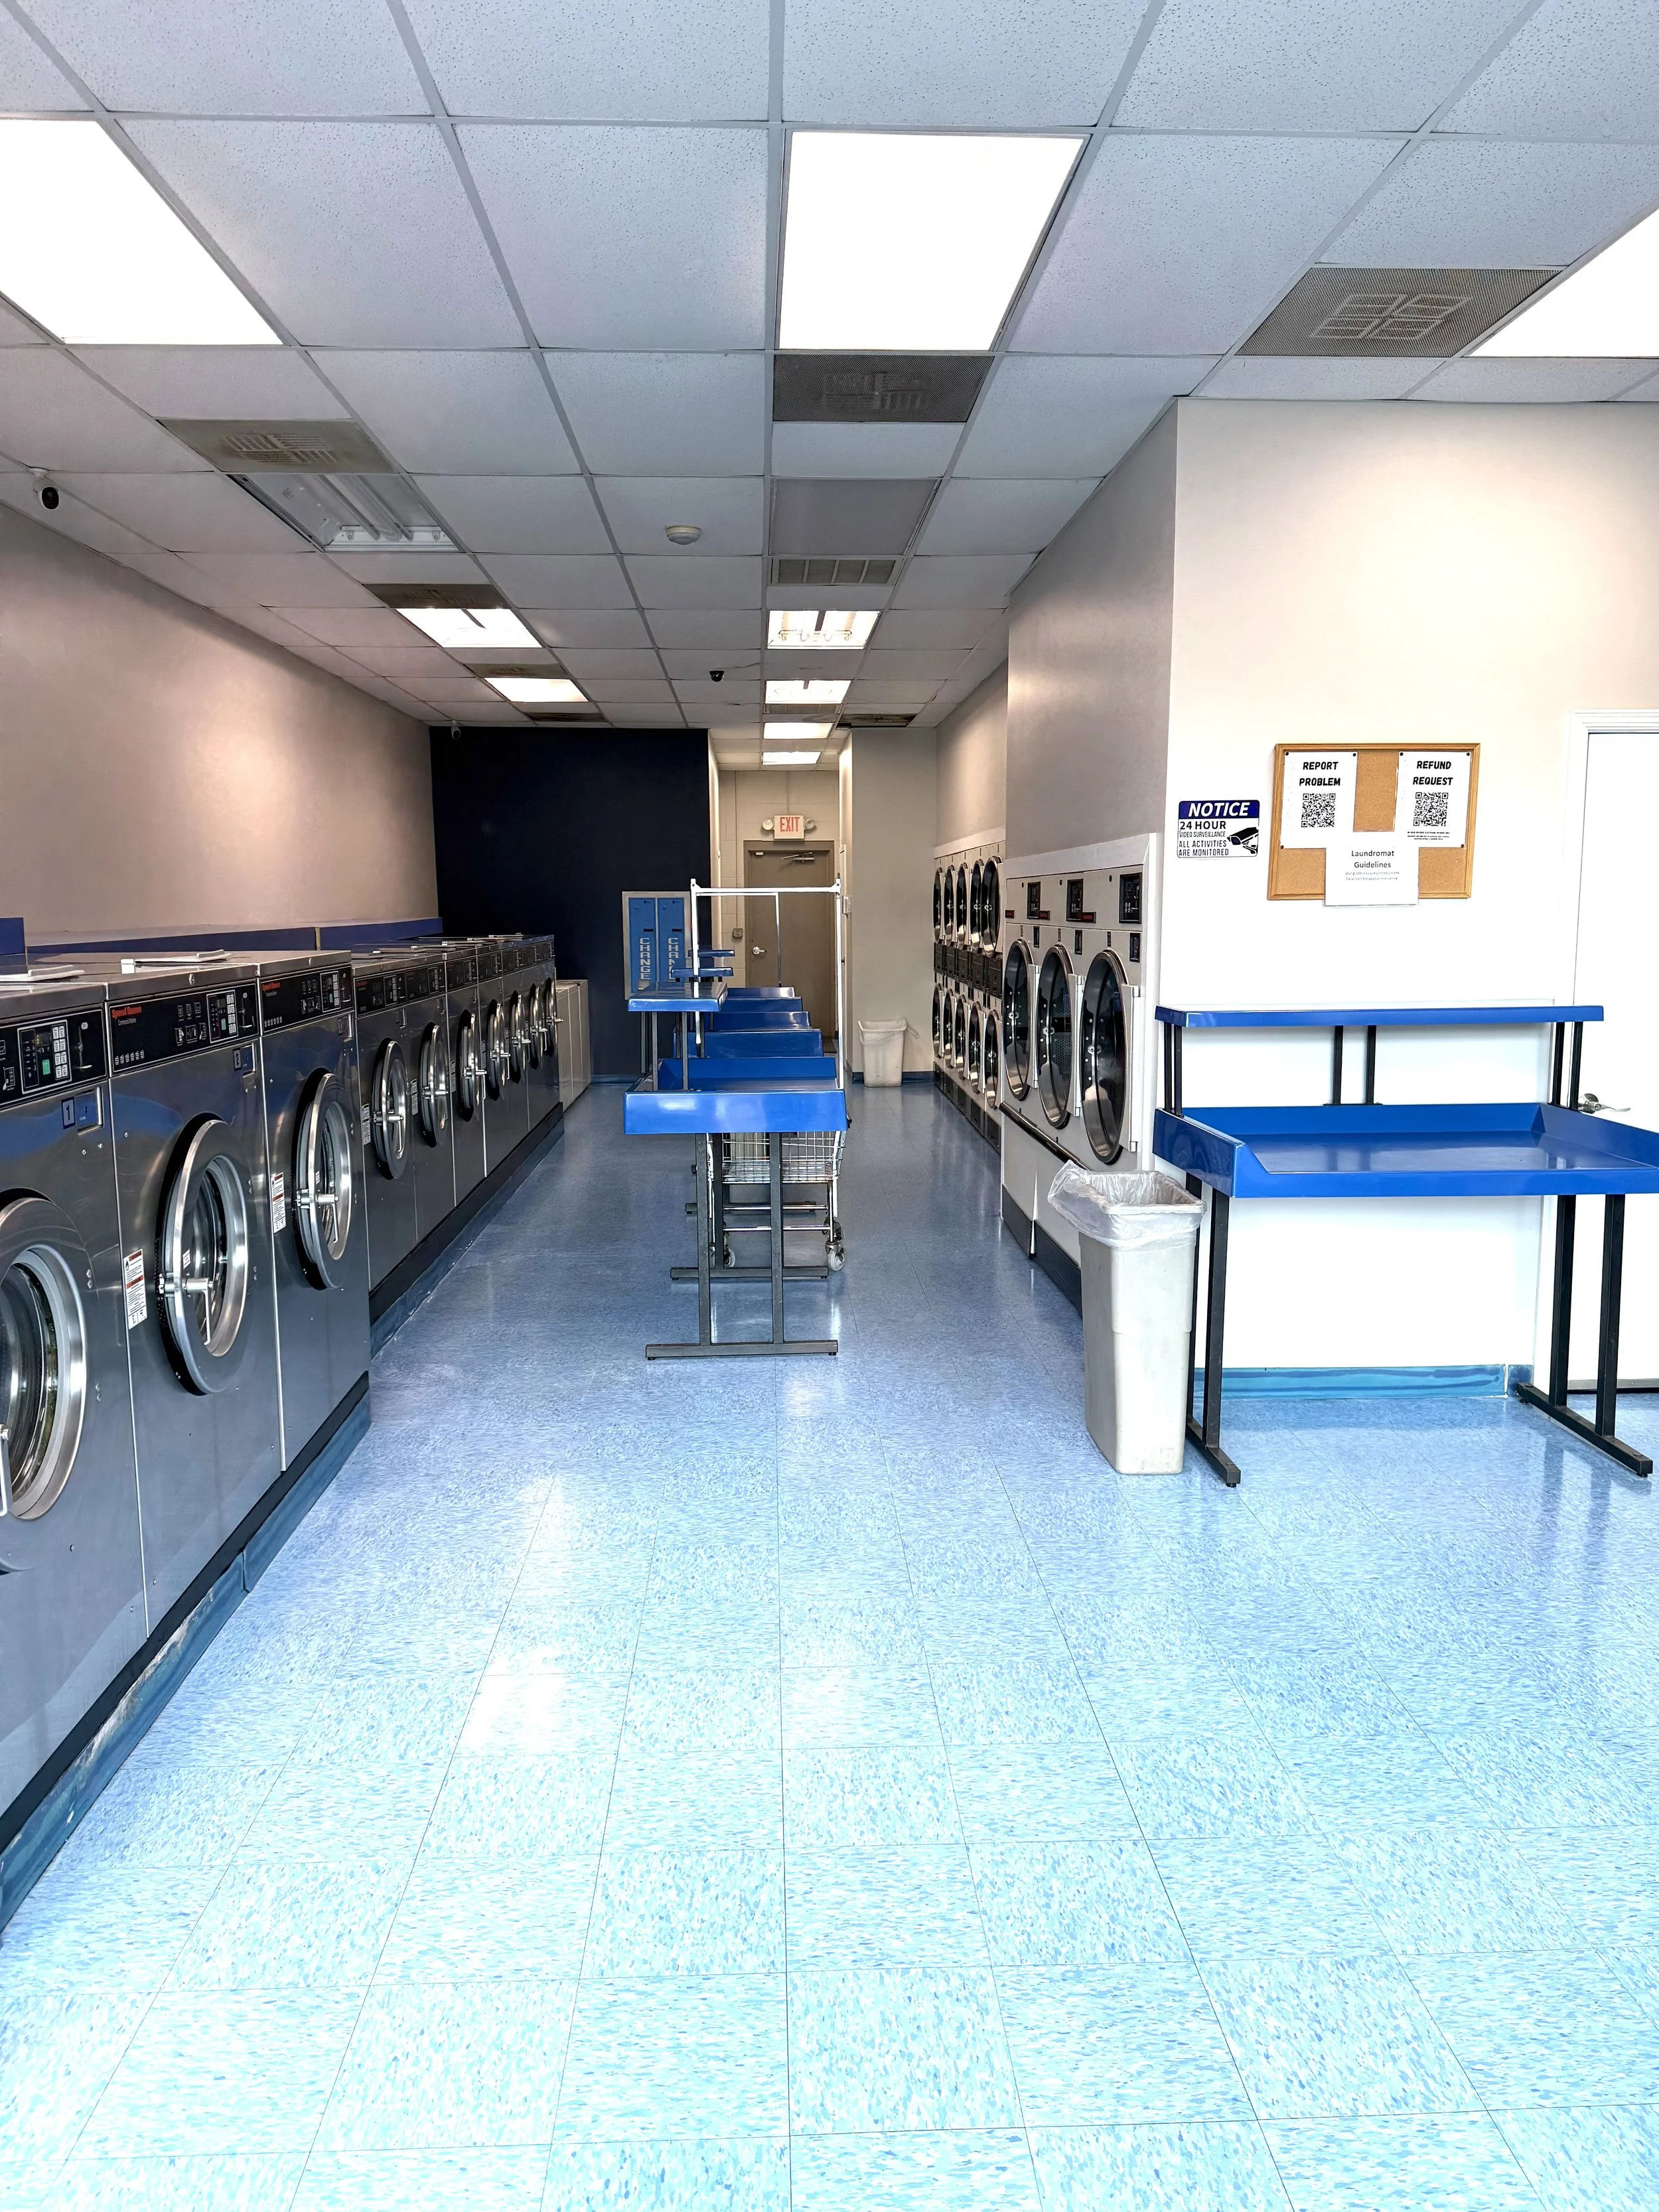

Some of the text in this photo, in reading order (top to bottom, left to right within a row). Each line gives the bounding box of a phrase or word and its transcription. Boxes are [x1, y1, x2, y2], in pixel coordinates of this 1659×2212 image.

[1303, 761, 1338, 770] REPORT
[1416, 761, 1451, 770] REFUND
[1299, 777, 1340, 786] PROBLEM
[1412, 776, 1453, 785] REQUEST
[1188, 802, 1250, 817] NOTICE
[780, 816, 800, 832] EXIT
[1180, 820, 1226, 830] 24 HOUR
[640, 938, 651, 980] CHANGE
[236, 1053, 240, 1066] 2
[66, 1104, 70, 1121] 1
